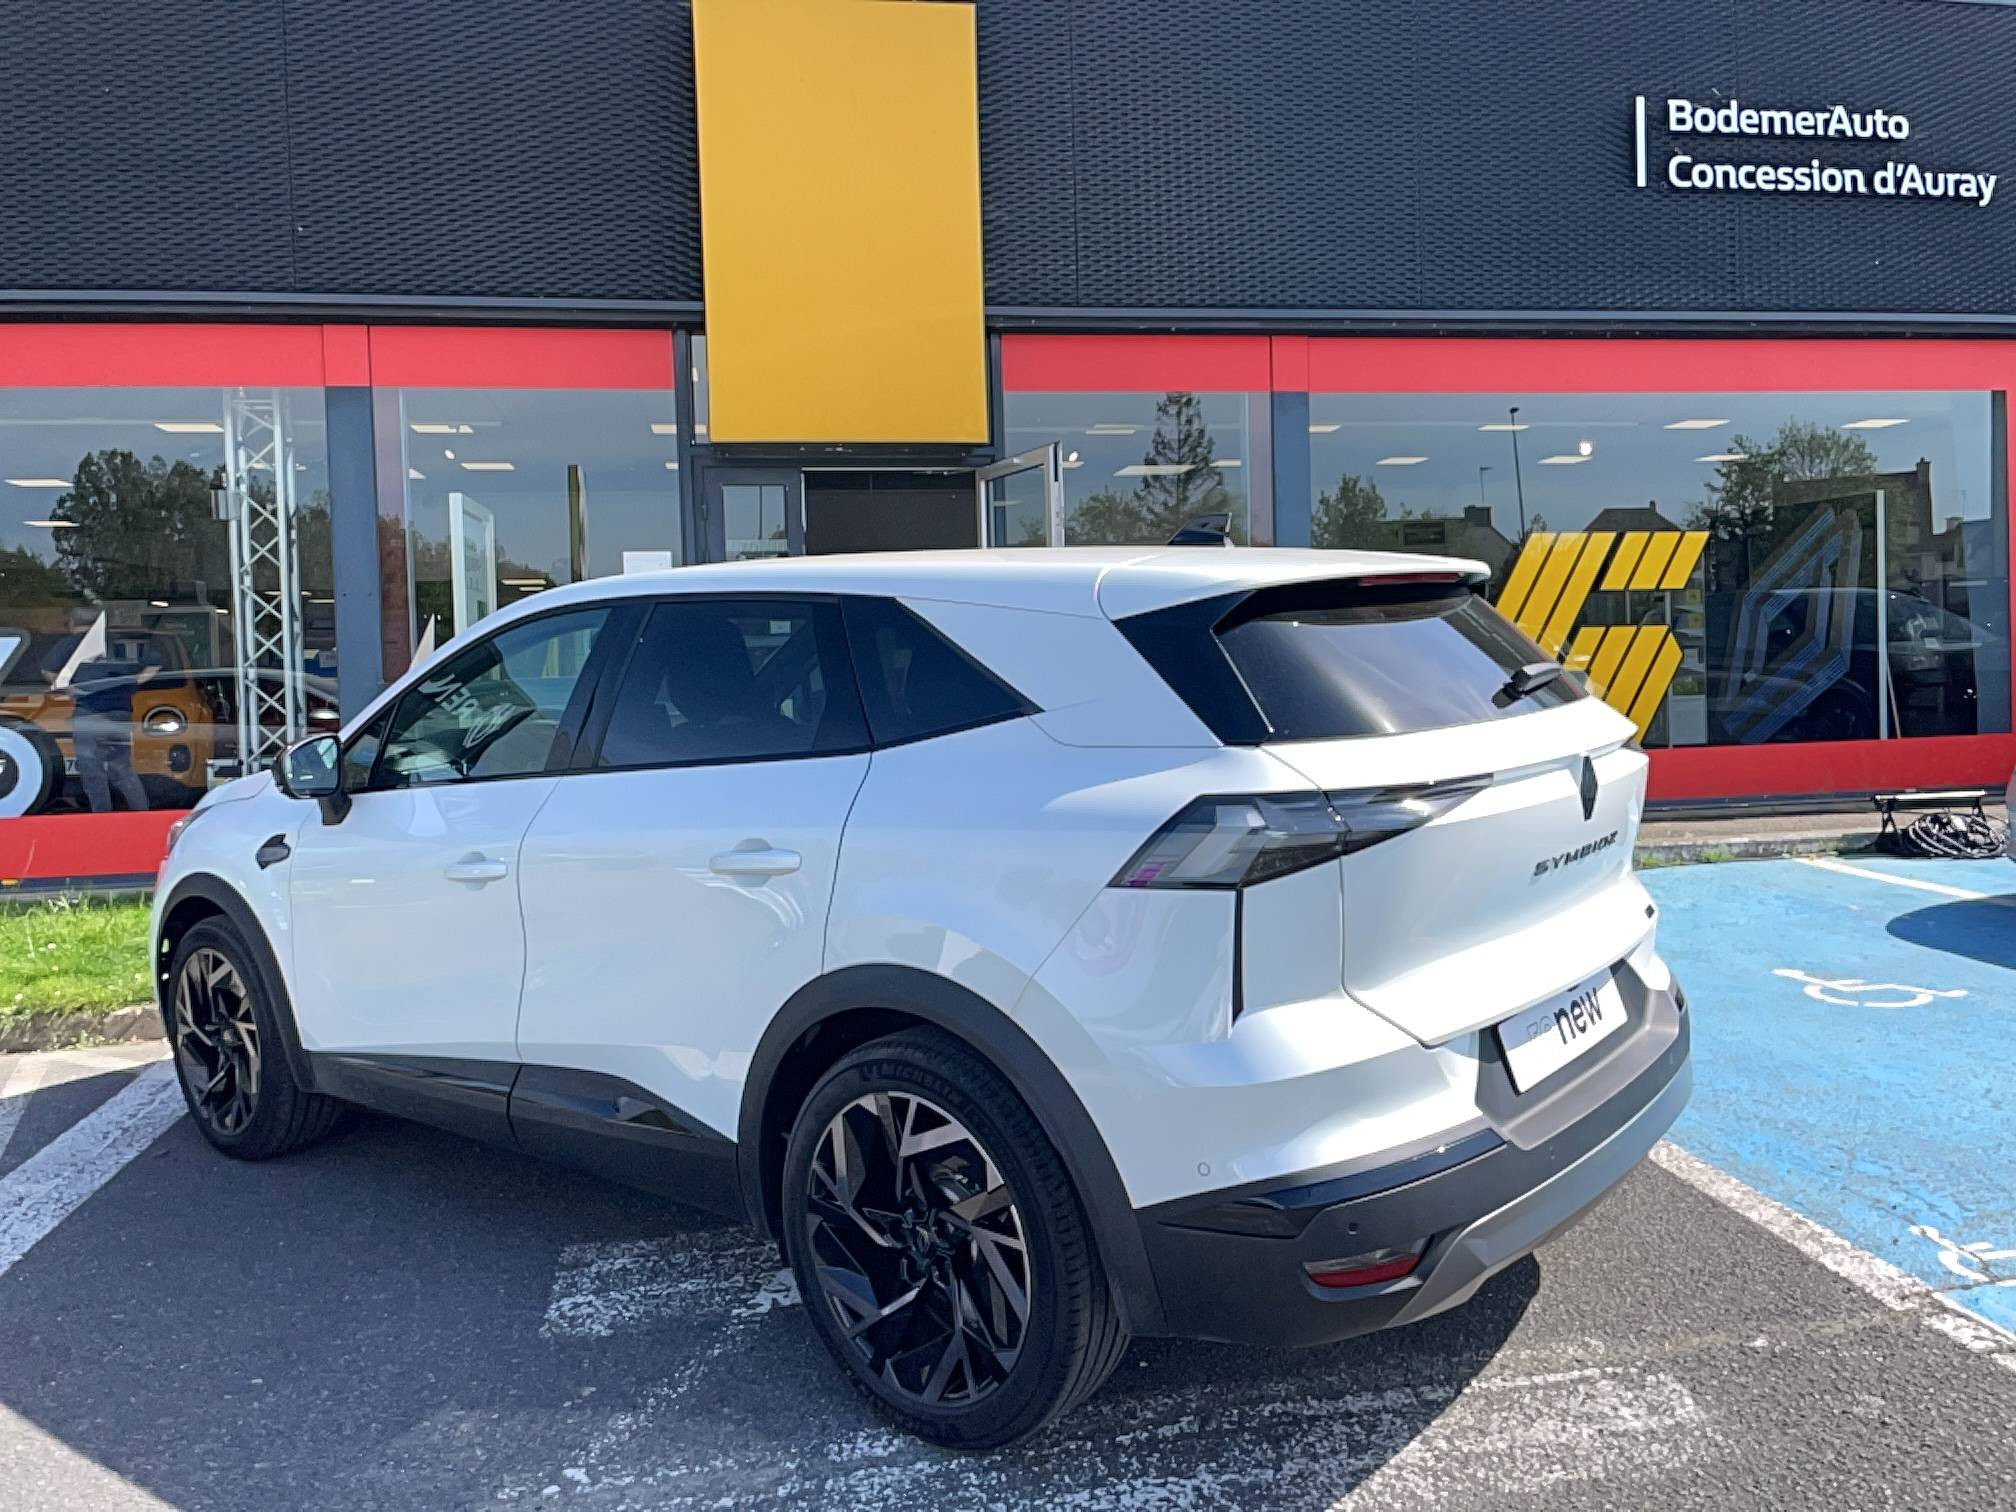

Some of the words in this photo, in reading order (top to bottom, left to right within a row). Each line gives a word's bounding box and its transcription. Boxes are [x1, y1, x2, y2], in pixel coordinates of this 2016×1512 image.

[1667, 98, 1910, 140] BodemerAuto
[1668, 154, 1867, 193] Concession
[1873, 160, 1997, 207] d'Auray
[1533, 829, 1618, 877] SYMBIOZ
